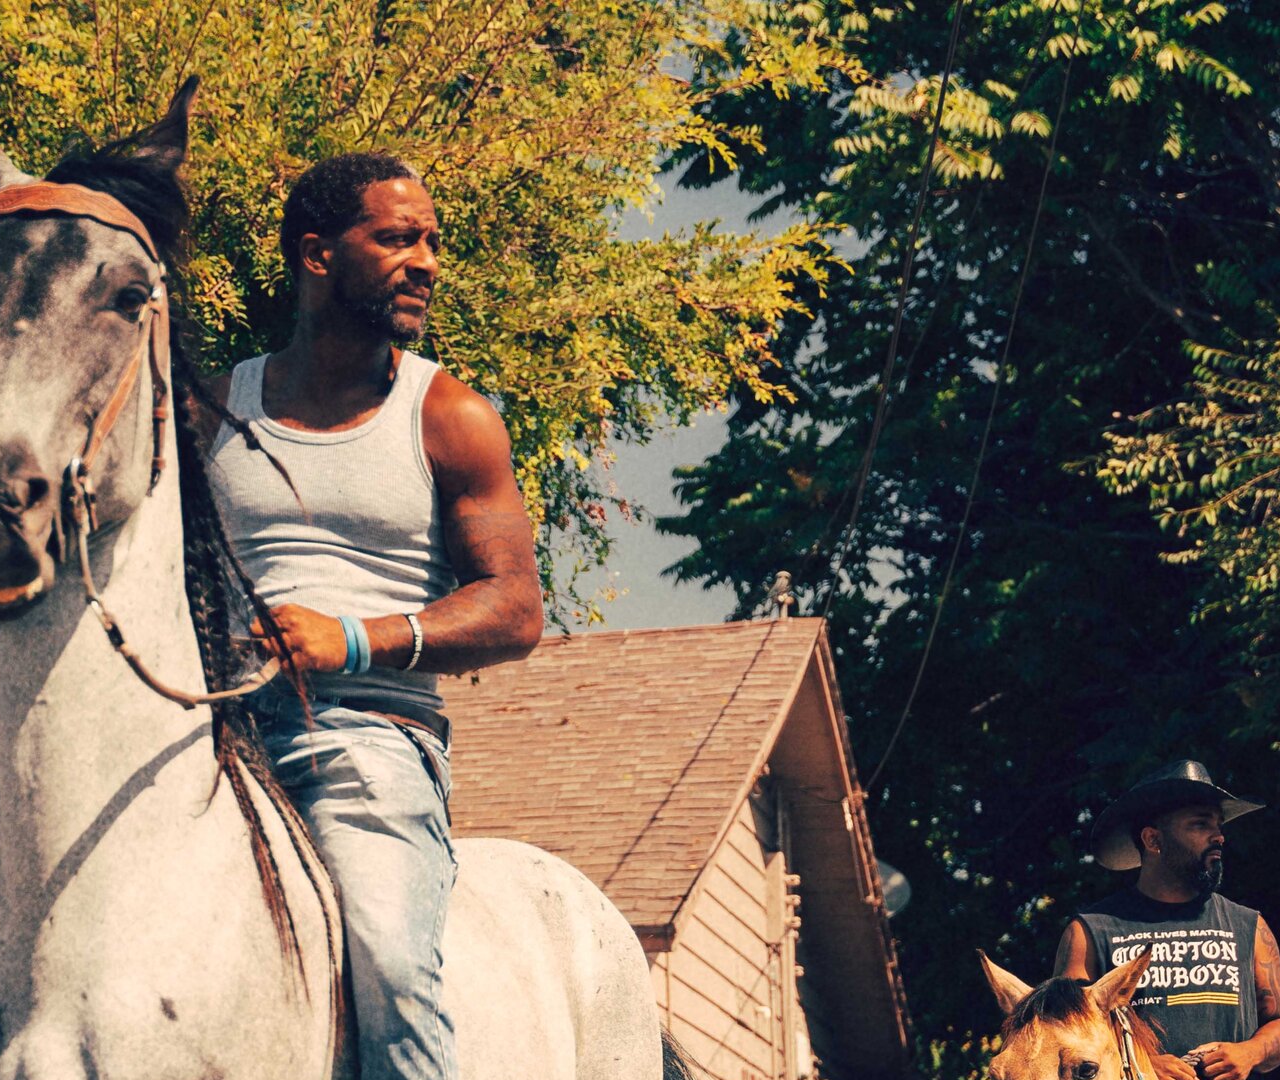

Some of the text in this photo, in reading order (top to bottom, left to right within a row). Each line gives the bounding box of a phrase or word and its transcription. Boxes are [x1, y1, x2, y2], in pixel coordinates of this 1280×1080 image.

[1112, 929, 1234, 943] BLACK LIVES MATTER
[1134, 963, 1240, 987] OWBOYS
[1131, 996, 1163, 1006] ARIAT
